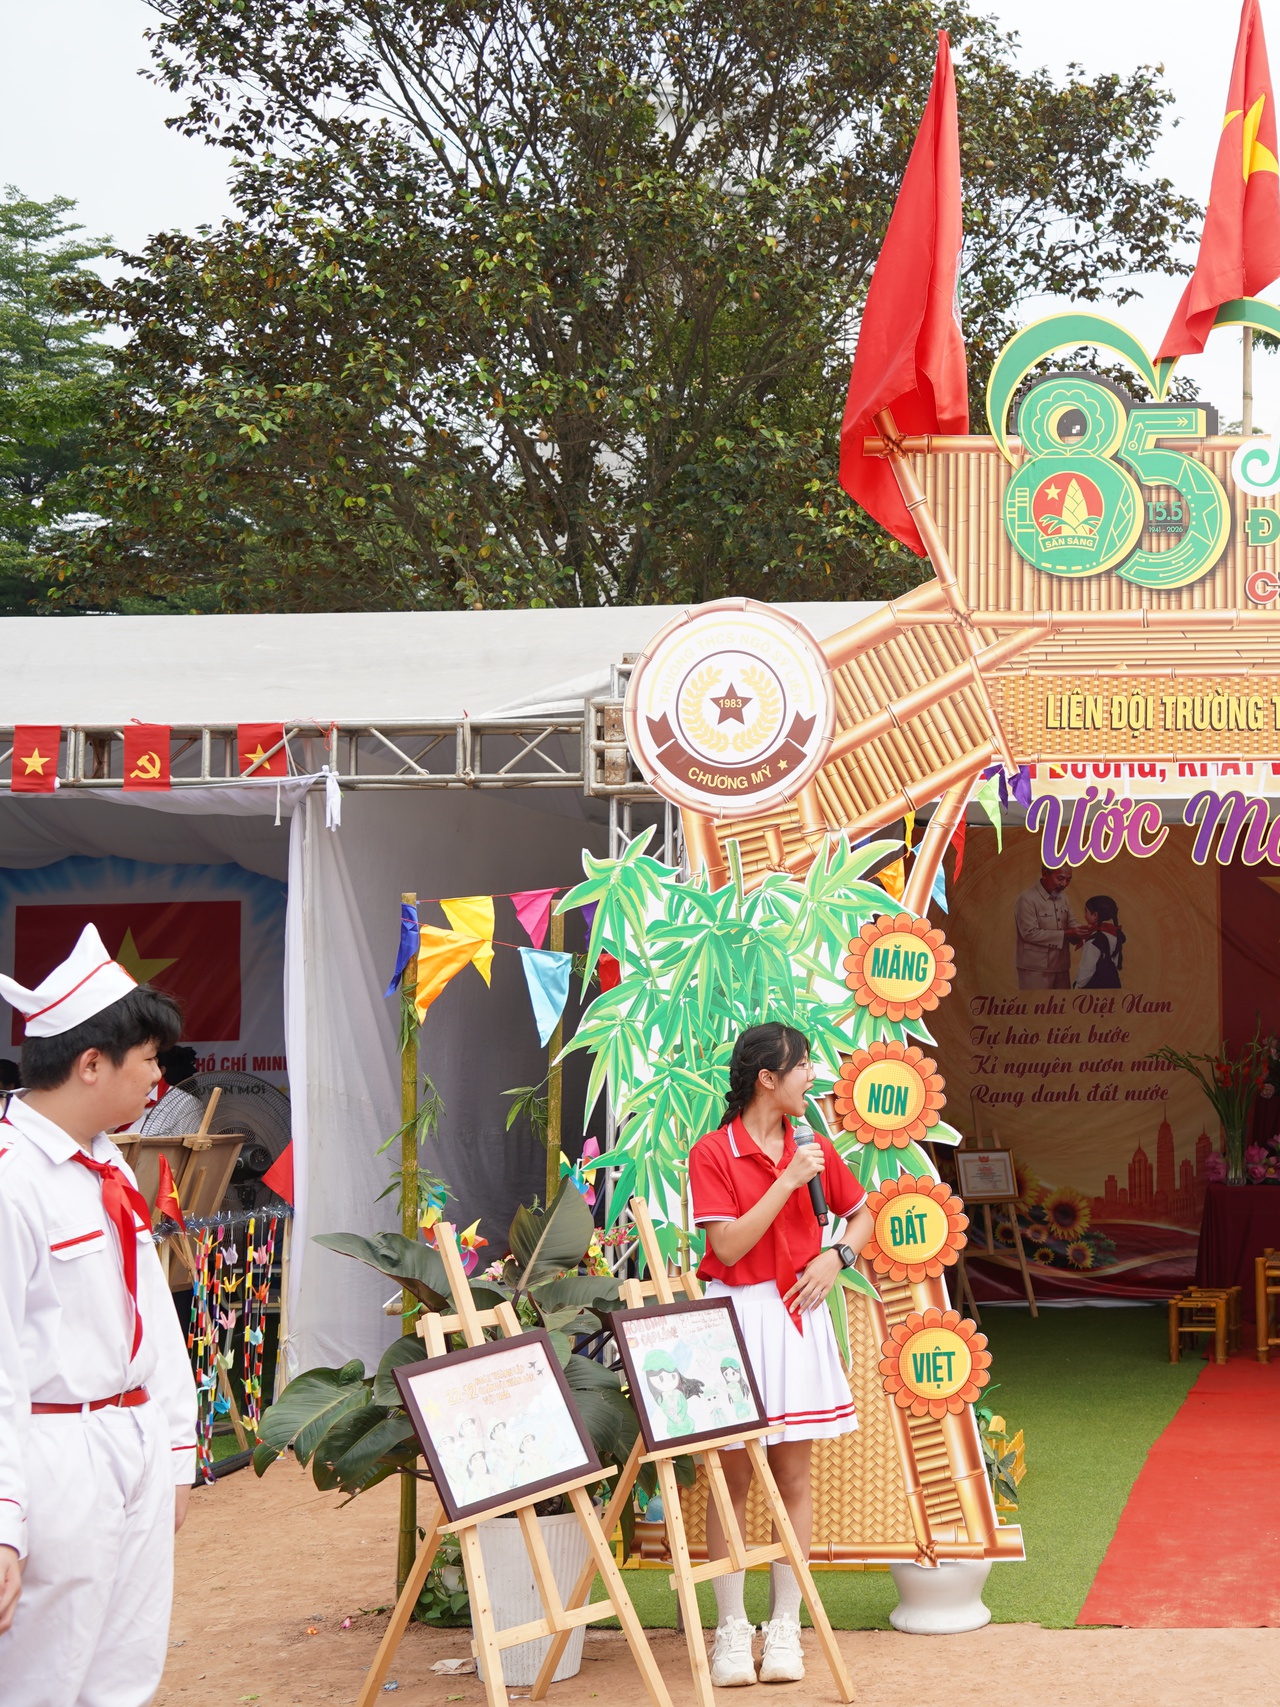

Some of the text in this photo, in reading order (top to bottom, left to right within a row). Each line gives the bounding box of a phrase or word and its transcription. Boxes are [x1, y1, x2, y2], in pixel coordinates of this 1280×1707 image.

[1147, 501, 1183, 521] 15.5
[697, 632, 736, 650] THCS
[718, 698, 743, 708] 1983
[1046, 687, 1103, 730] LIÊN
[1110, 688, 1154, 738] ĐỘI
[1162, 687, 1264, 731] TRƯỜNG
[688, 764, 772, 790] CHƯƠNG MỸ
[1025, 786, 1169, 869] Ước
[871, 944, 929, 982] MĂNG
[970, 993, 1173, 1018] Thiếu nhi Việt Nam
[970, 1024, 1131, 1049] Tự hào tiến bước
[196, 1053, 216, 1072] HỒ
[220, 1053, 247, 1072] CHÍ
[1003, 1056, 1074, 1078] nguyên
[1079, 1059, 1125, 1073] vươn
[867, 1082, 909, 1117] NON
[970, 1082, 1169, 1108] Rạng danh đất nước
[890, 1205, 928, 1247] ĐẤT
[912, 1345, 956, 1389] VIỆT
